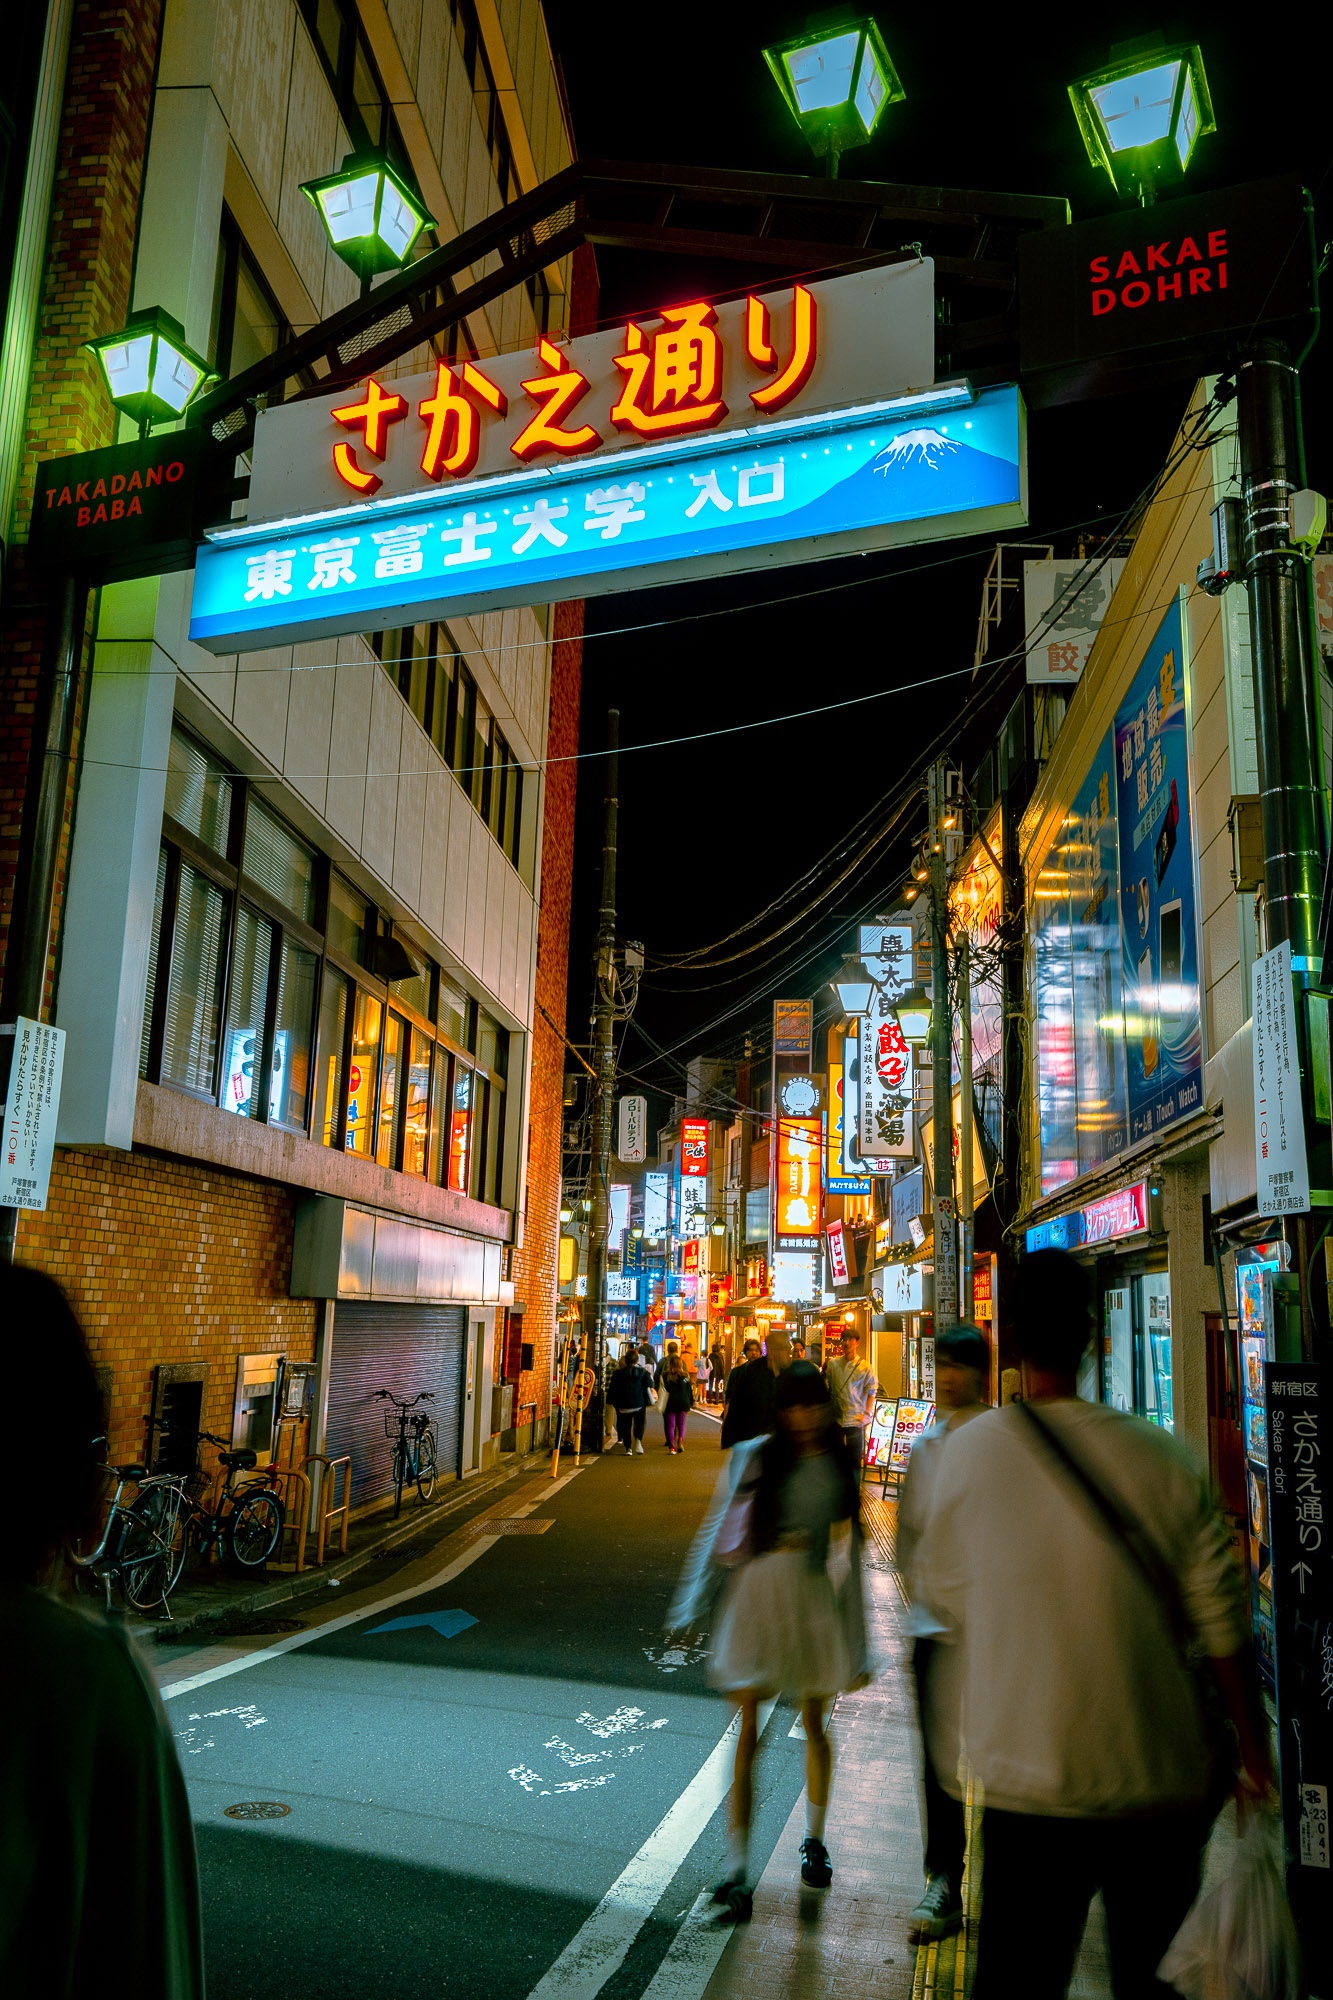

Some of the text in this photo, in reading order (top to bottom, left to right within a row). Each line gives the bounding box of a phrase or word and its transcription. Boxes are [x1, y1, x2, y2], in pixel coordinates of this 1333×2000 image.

[1089, 229, 1228, 284] SAKAE
[1091, 262, 1228, 316] DOHRI
[331, 285, 817, 494] さかえ通り
[46, 462, 185, 508] TAKADANO
[77, 496, 142, 527] BABA
[244, 462, 786, 603] 東京富士大学 入口
[1047, 642, 1092, 673] 餃
[1156, 1095, 1174, 1124] iTouch
[1178, 1081, 1198, 1109] Watch
[1086, 1195, 1139, 1242] ダイワンテレコム
[627, 1234, 637, 1271] JELLY
[1272, 1381, 1318, 1396] 新宿区
[1272, 1410, 1285, 1453] Sakae
[1274, 1467, 1287, 1494] dori
[1292, 1410, 1323, 1551] さかえ通り
